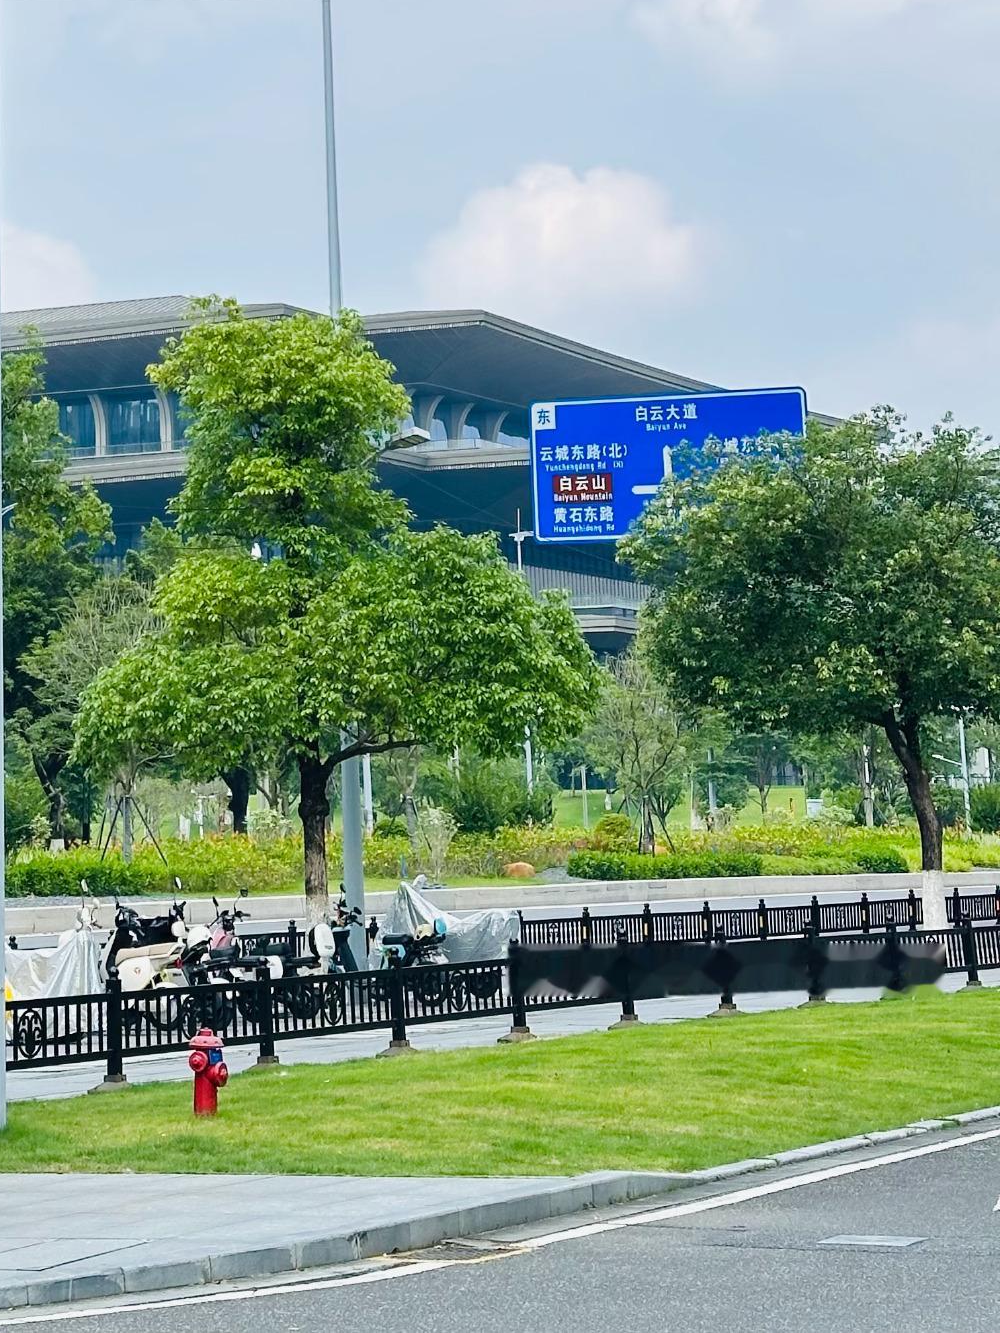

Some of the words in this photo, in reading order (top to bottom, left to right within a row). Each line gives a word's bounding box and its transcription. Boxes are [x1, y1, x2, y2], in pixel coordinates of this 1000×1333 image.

[536, 408, 551, 425] 东
[635, 402, 698, 422] 白云大道
[559, 474, 606, 491] 白云山
[553, 493, 578, 503] Baiyun
[581, 492, 613, 501] Mountain
[553, 506, 614, 524] 黄石东路
